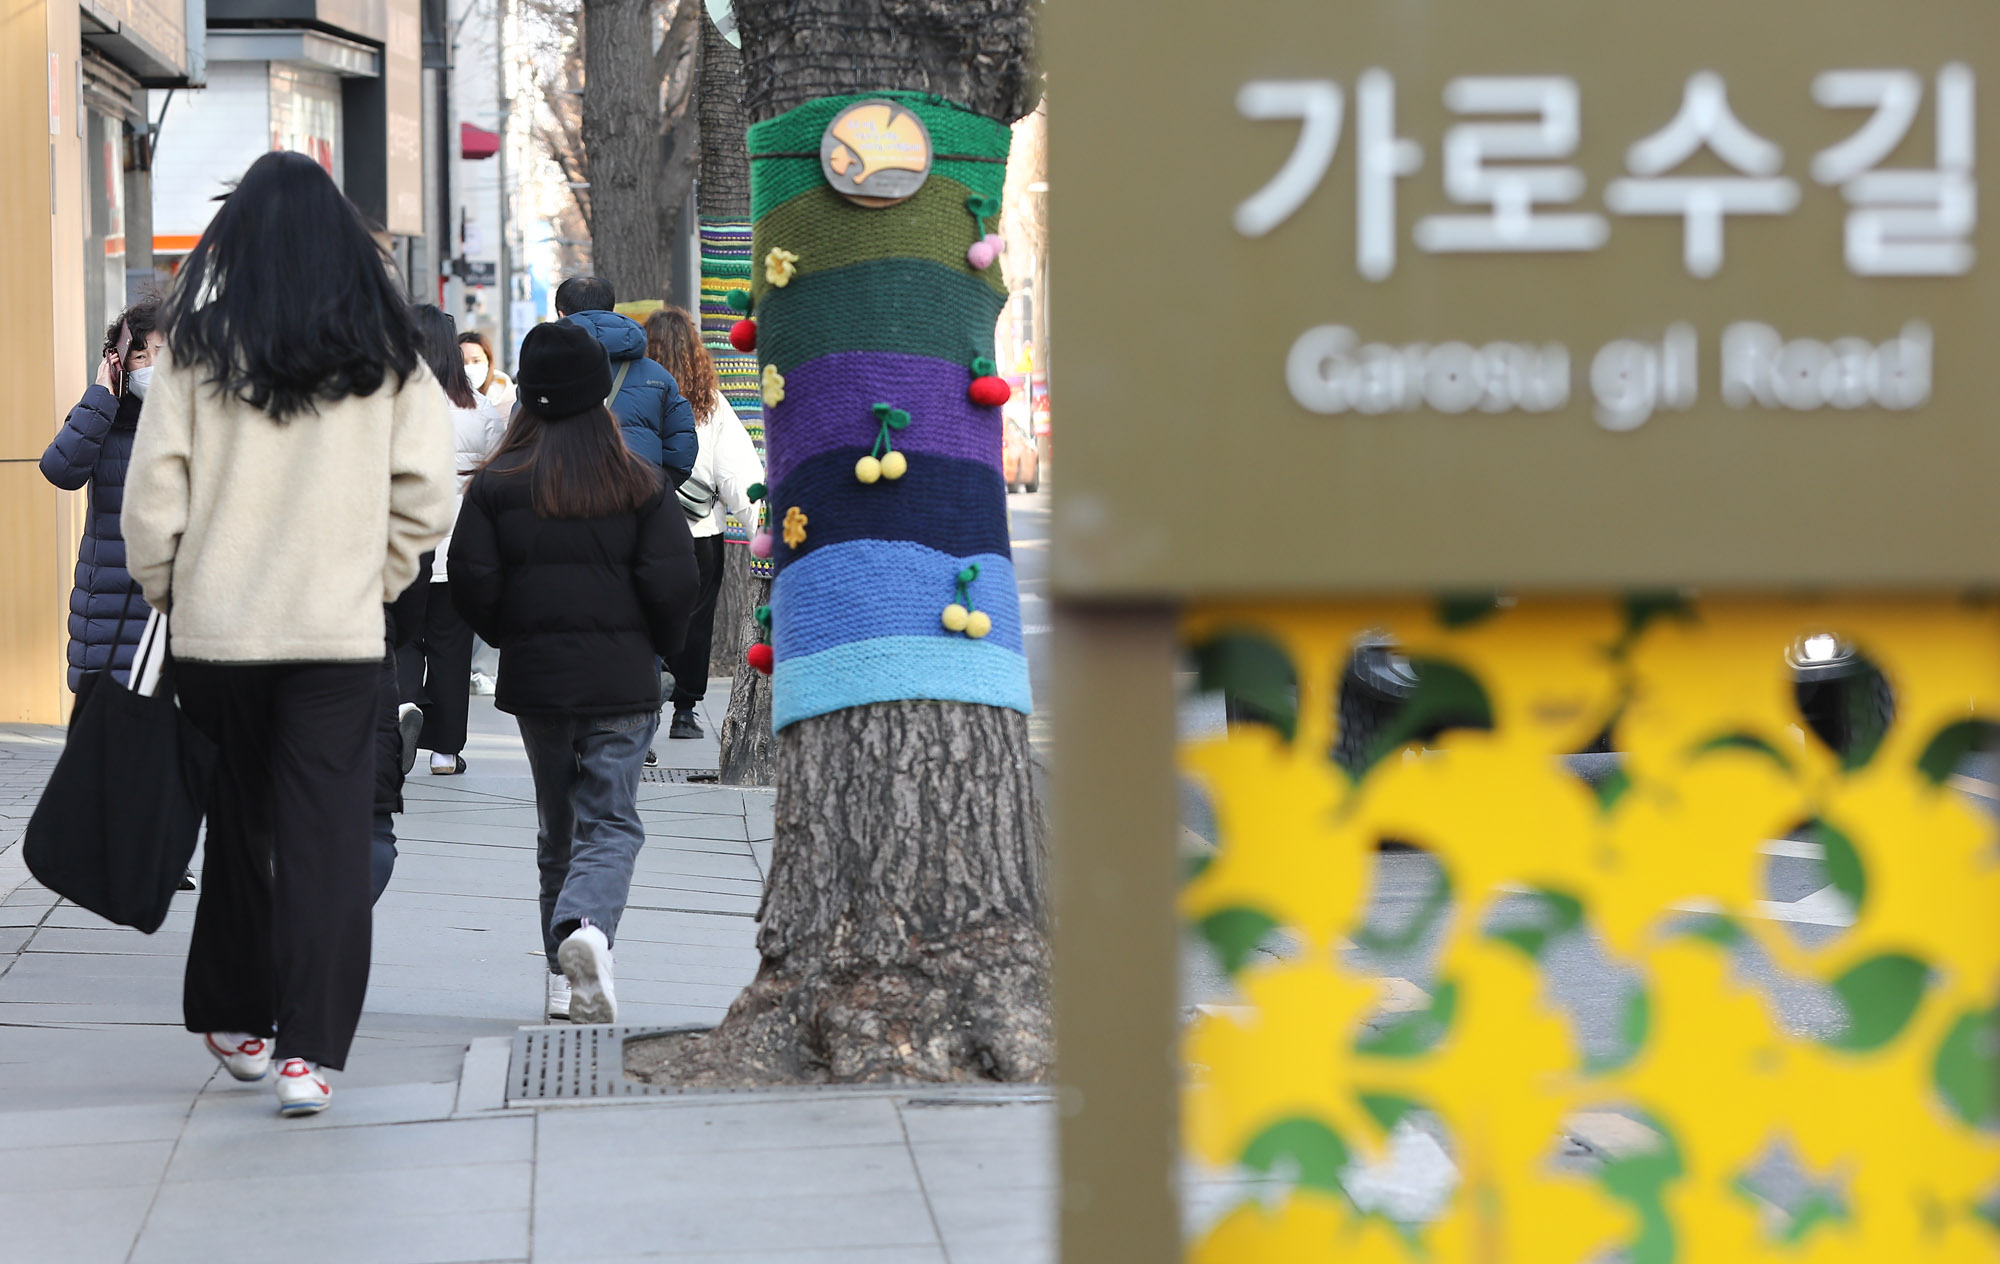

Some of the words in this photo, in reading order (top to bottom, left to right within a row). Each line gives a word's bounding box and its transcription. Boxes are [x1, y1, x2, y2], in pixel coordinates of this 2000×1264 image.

[1232, 62, 1976, 282] 가로수길
[1285, 323, 1571, 415] Garosu
[1590, 320, 1698, 432] gil
[1720, 318, 1934, 410] Road
